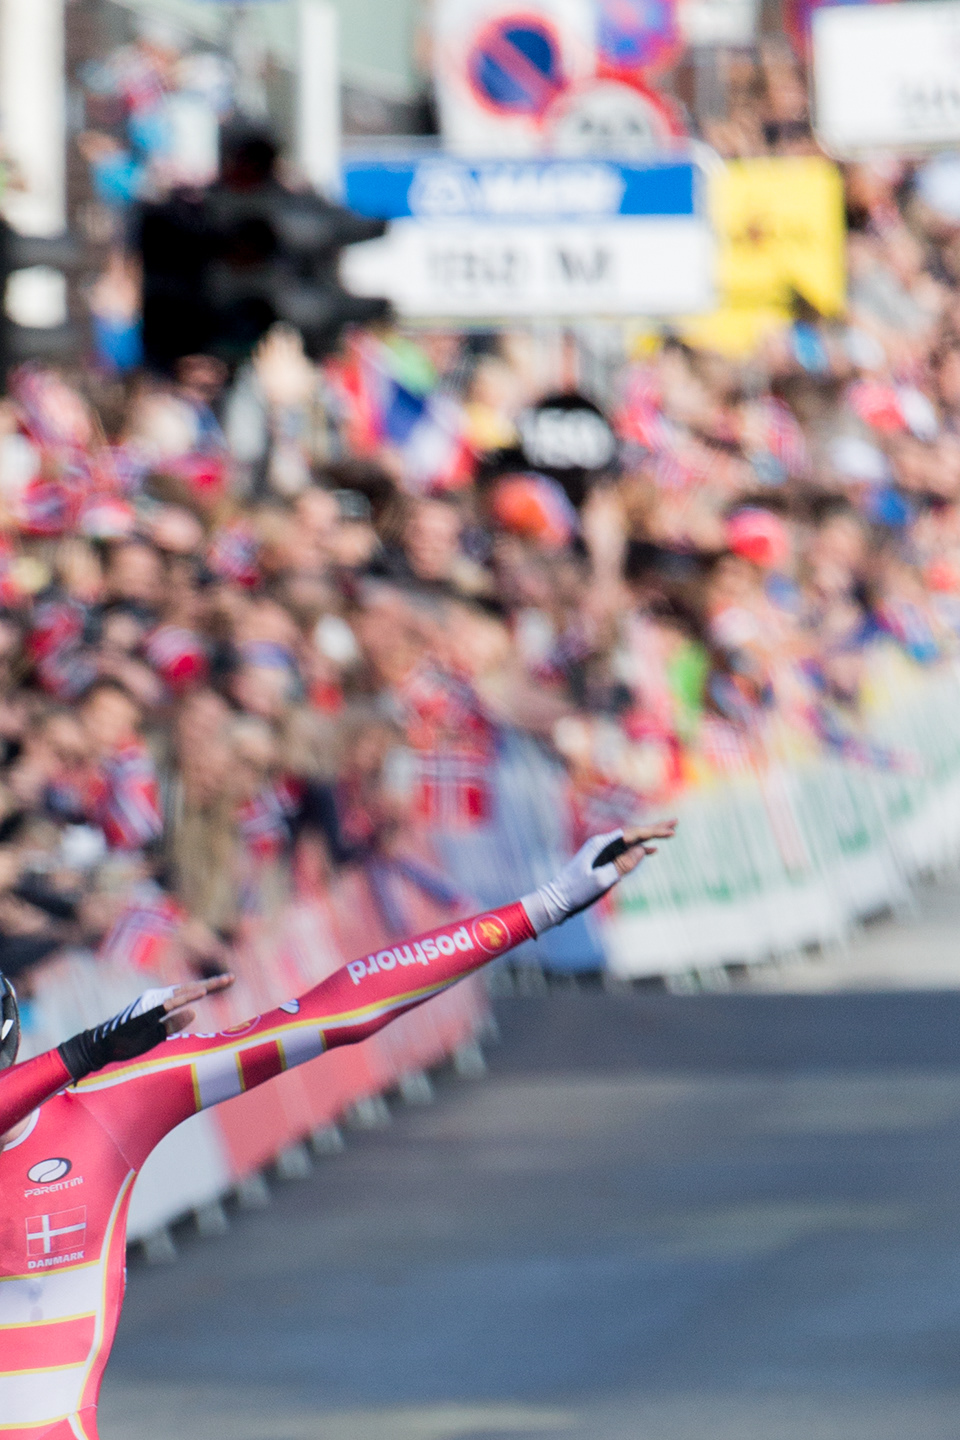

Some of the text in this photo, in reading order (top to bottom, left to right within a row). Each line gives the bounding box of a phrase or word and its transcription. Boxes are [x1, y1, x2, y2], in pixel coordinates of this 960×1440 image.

[346, 926, 474, 986] postnord
[24, 1176, 84, 1198] PARENTINI
[27, 1250, 84, 1269] DANMARK
